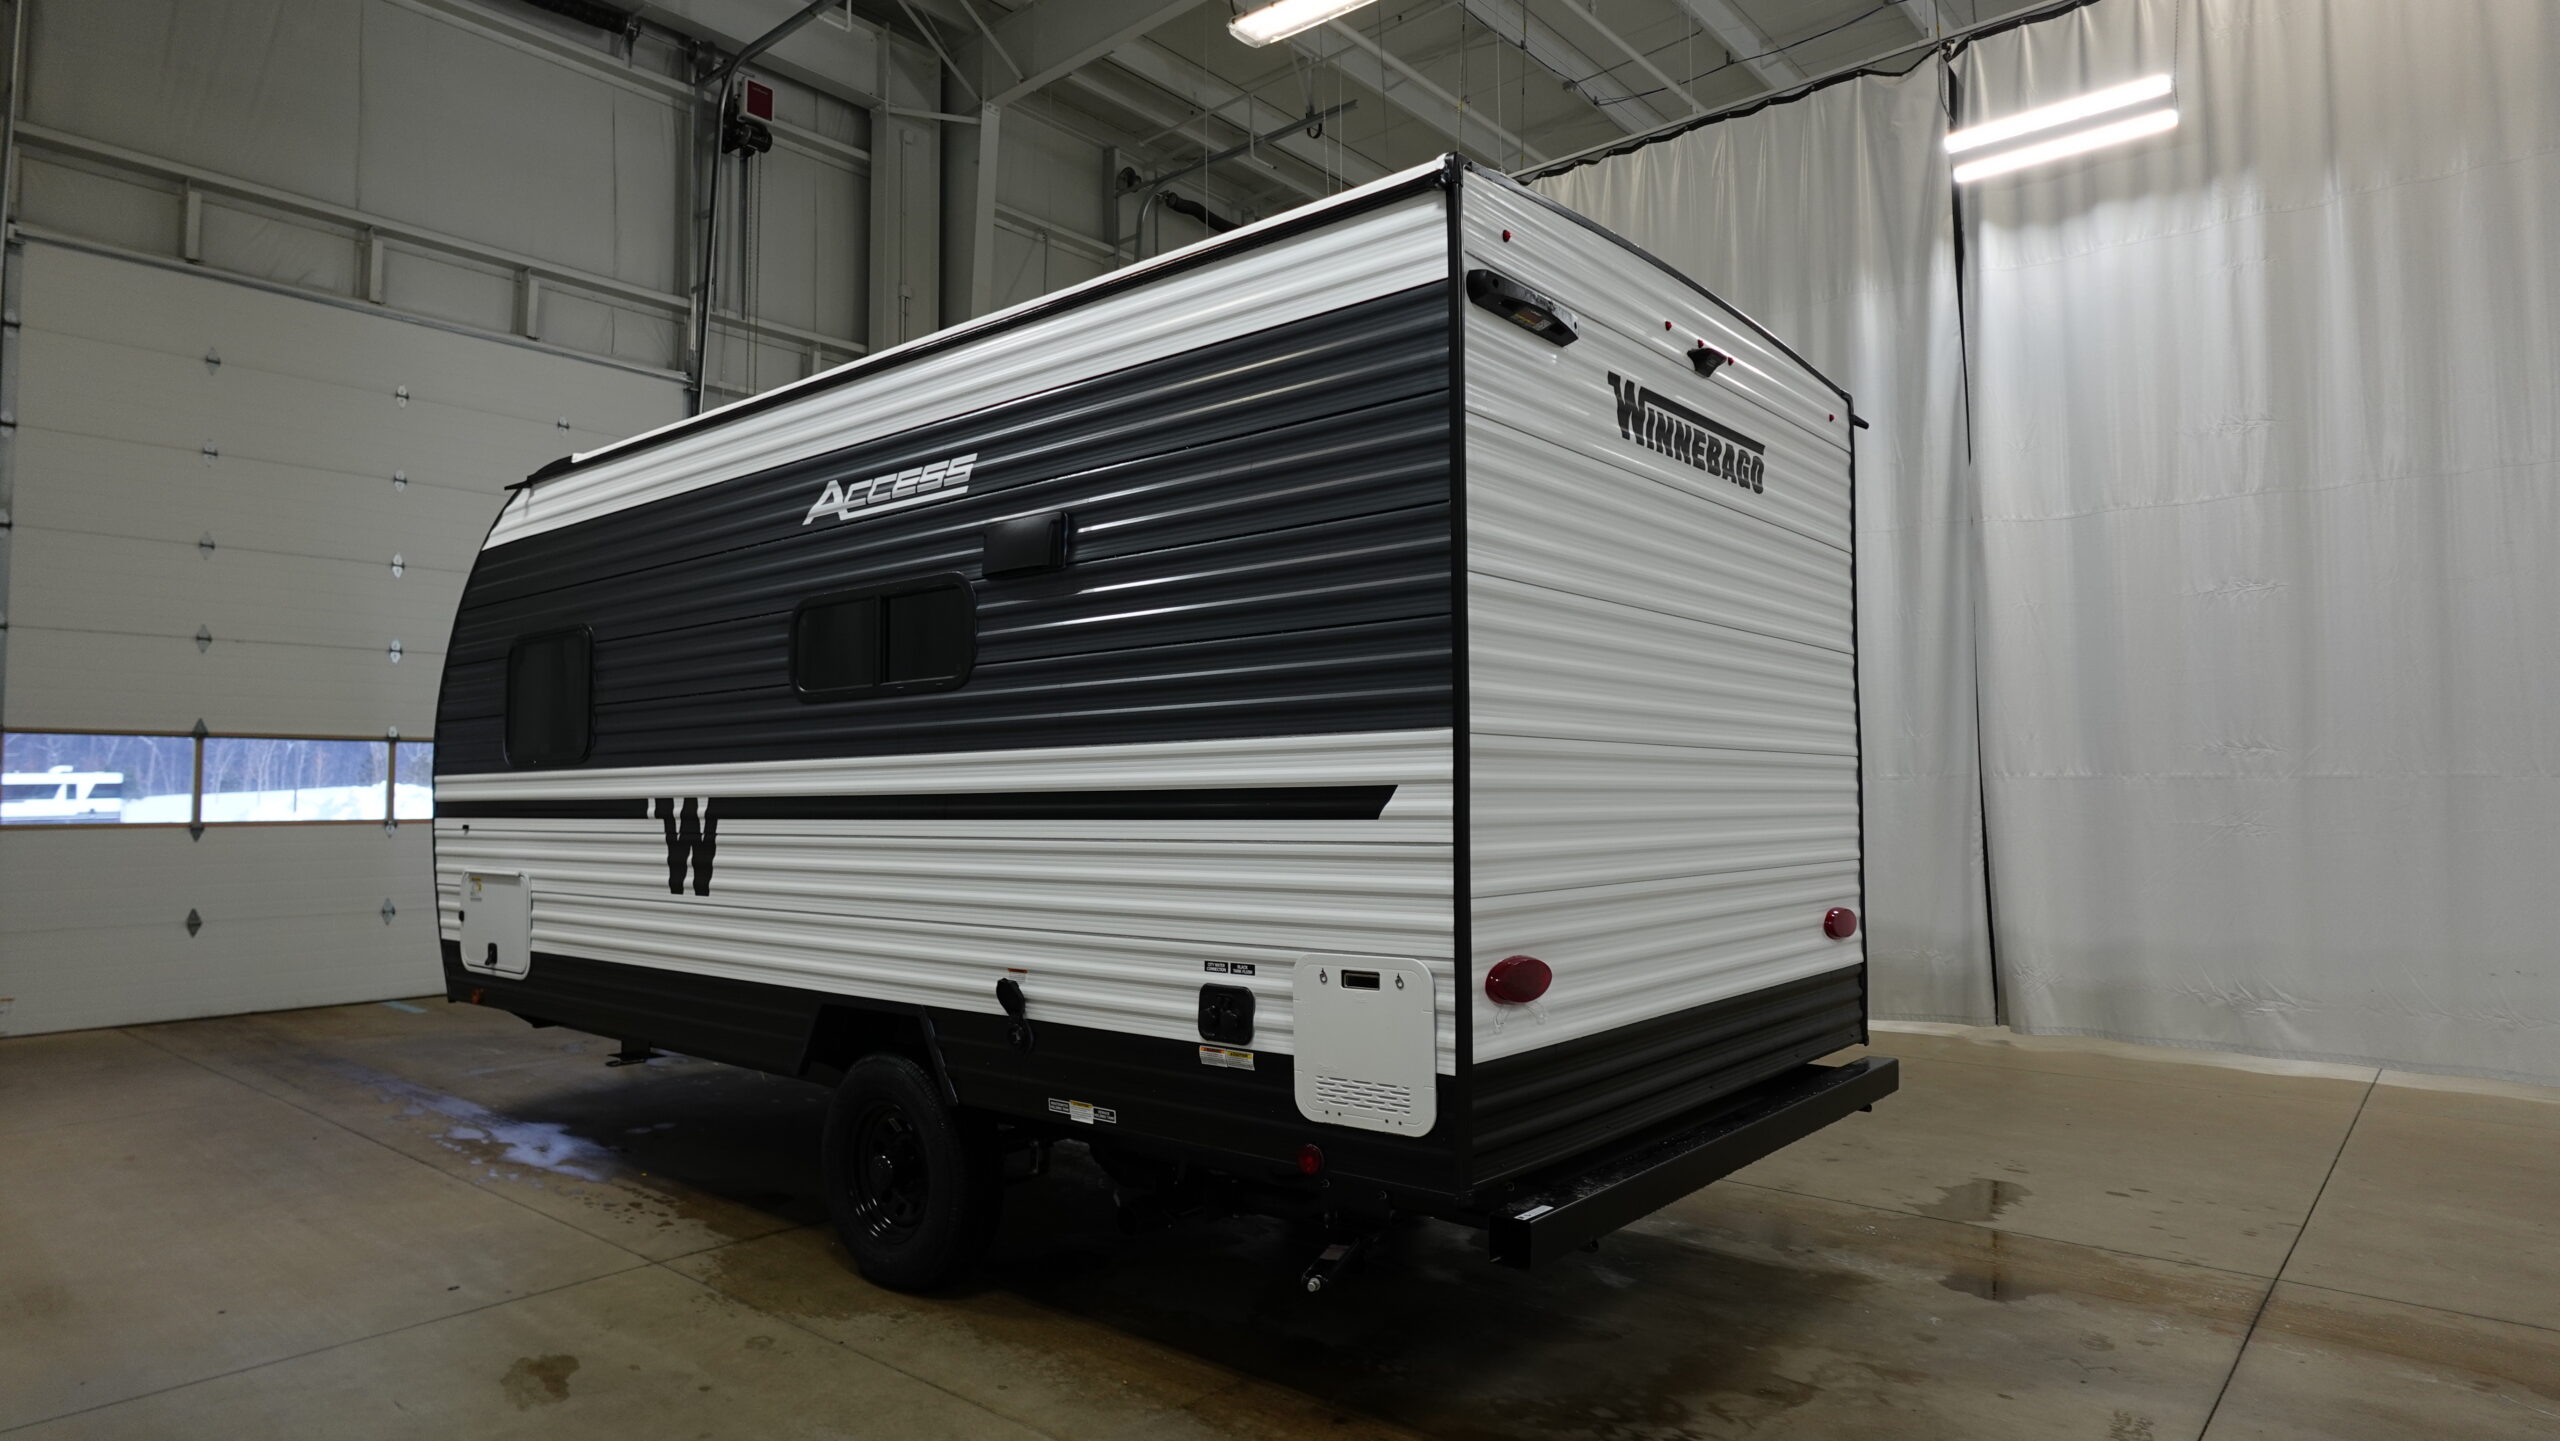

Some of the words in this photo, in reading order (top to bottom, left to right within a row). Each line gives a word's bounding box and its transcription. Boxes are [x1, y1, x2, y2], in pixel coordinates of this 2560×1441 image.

[1607, 370, 1766, 494] WINNEBAGO
[802, 452, 978, 525] ACCESS
[655, 796, 718, 897] W
